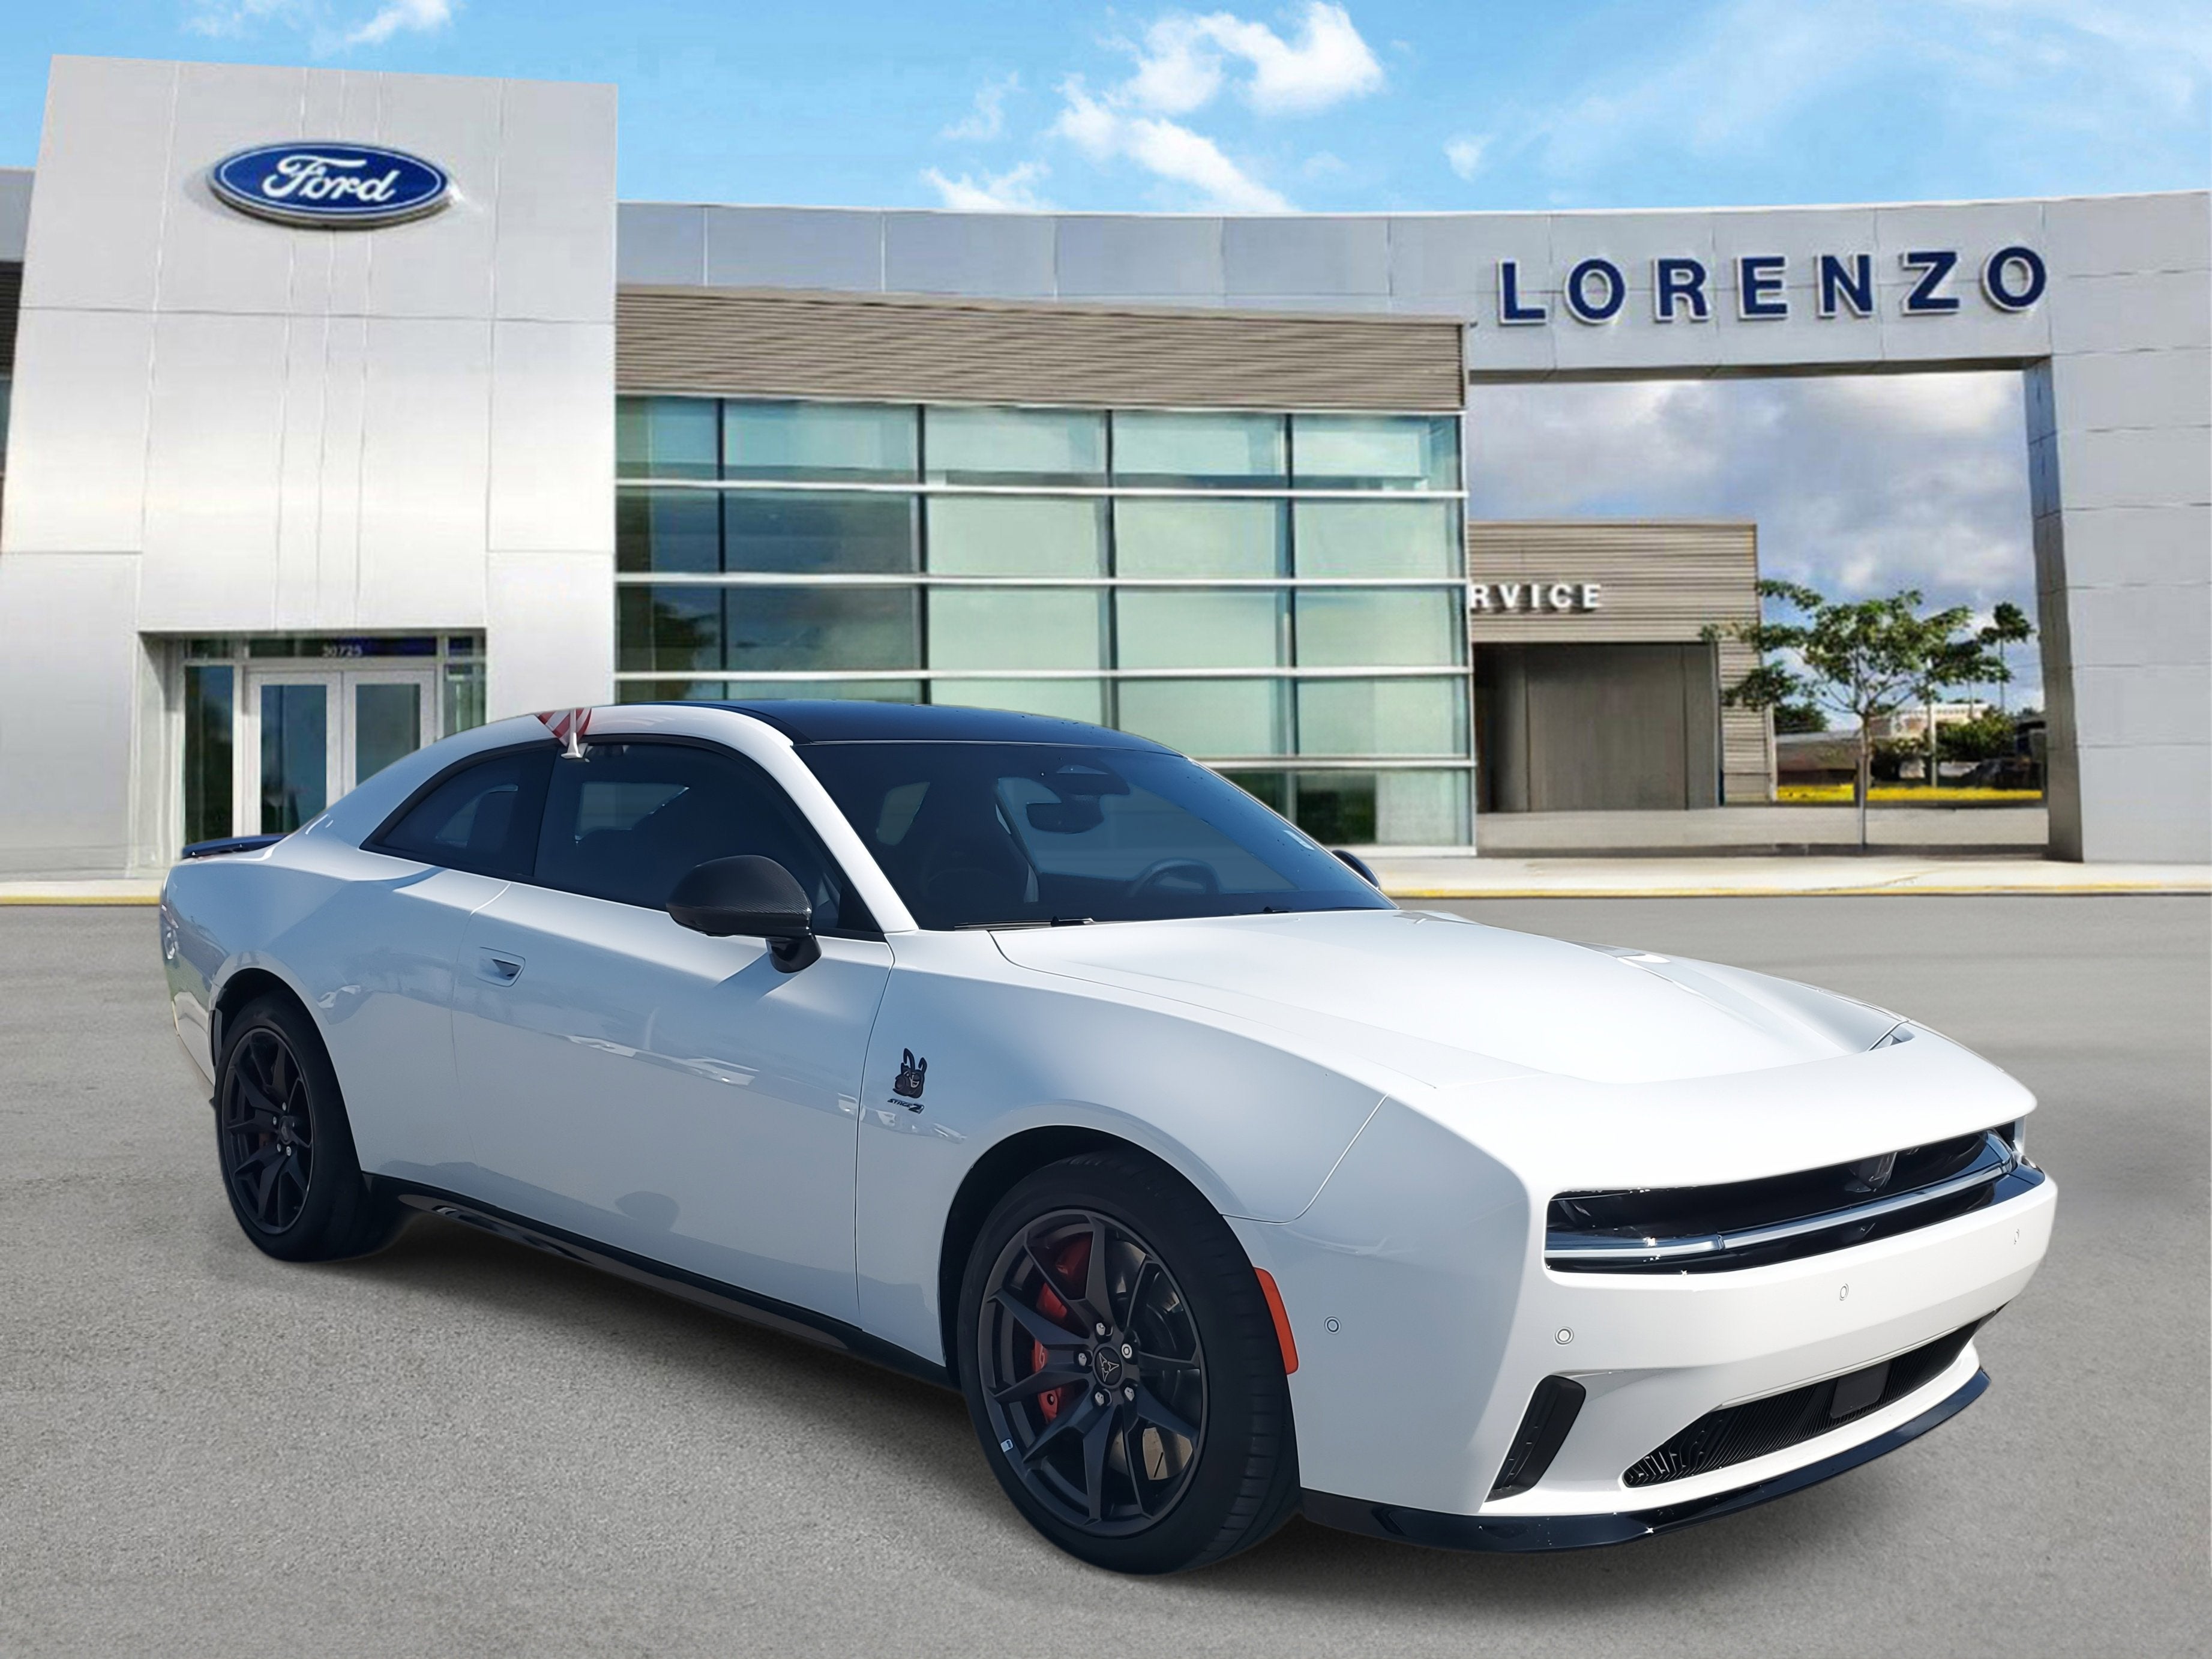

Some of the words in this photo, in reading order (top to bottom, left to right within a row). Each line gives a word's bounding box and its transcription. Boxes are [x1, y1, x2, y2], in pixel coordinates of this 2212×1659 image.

[262, 154, 400, 202] Ford
[1497, 246, 2048, 325] LORENZO
[1470, 584, 1602, 609] RVICE
